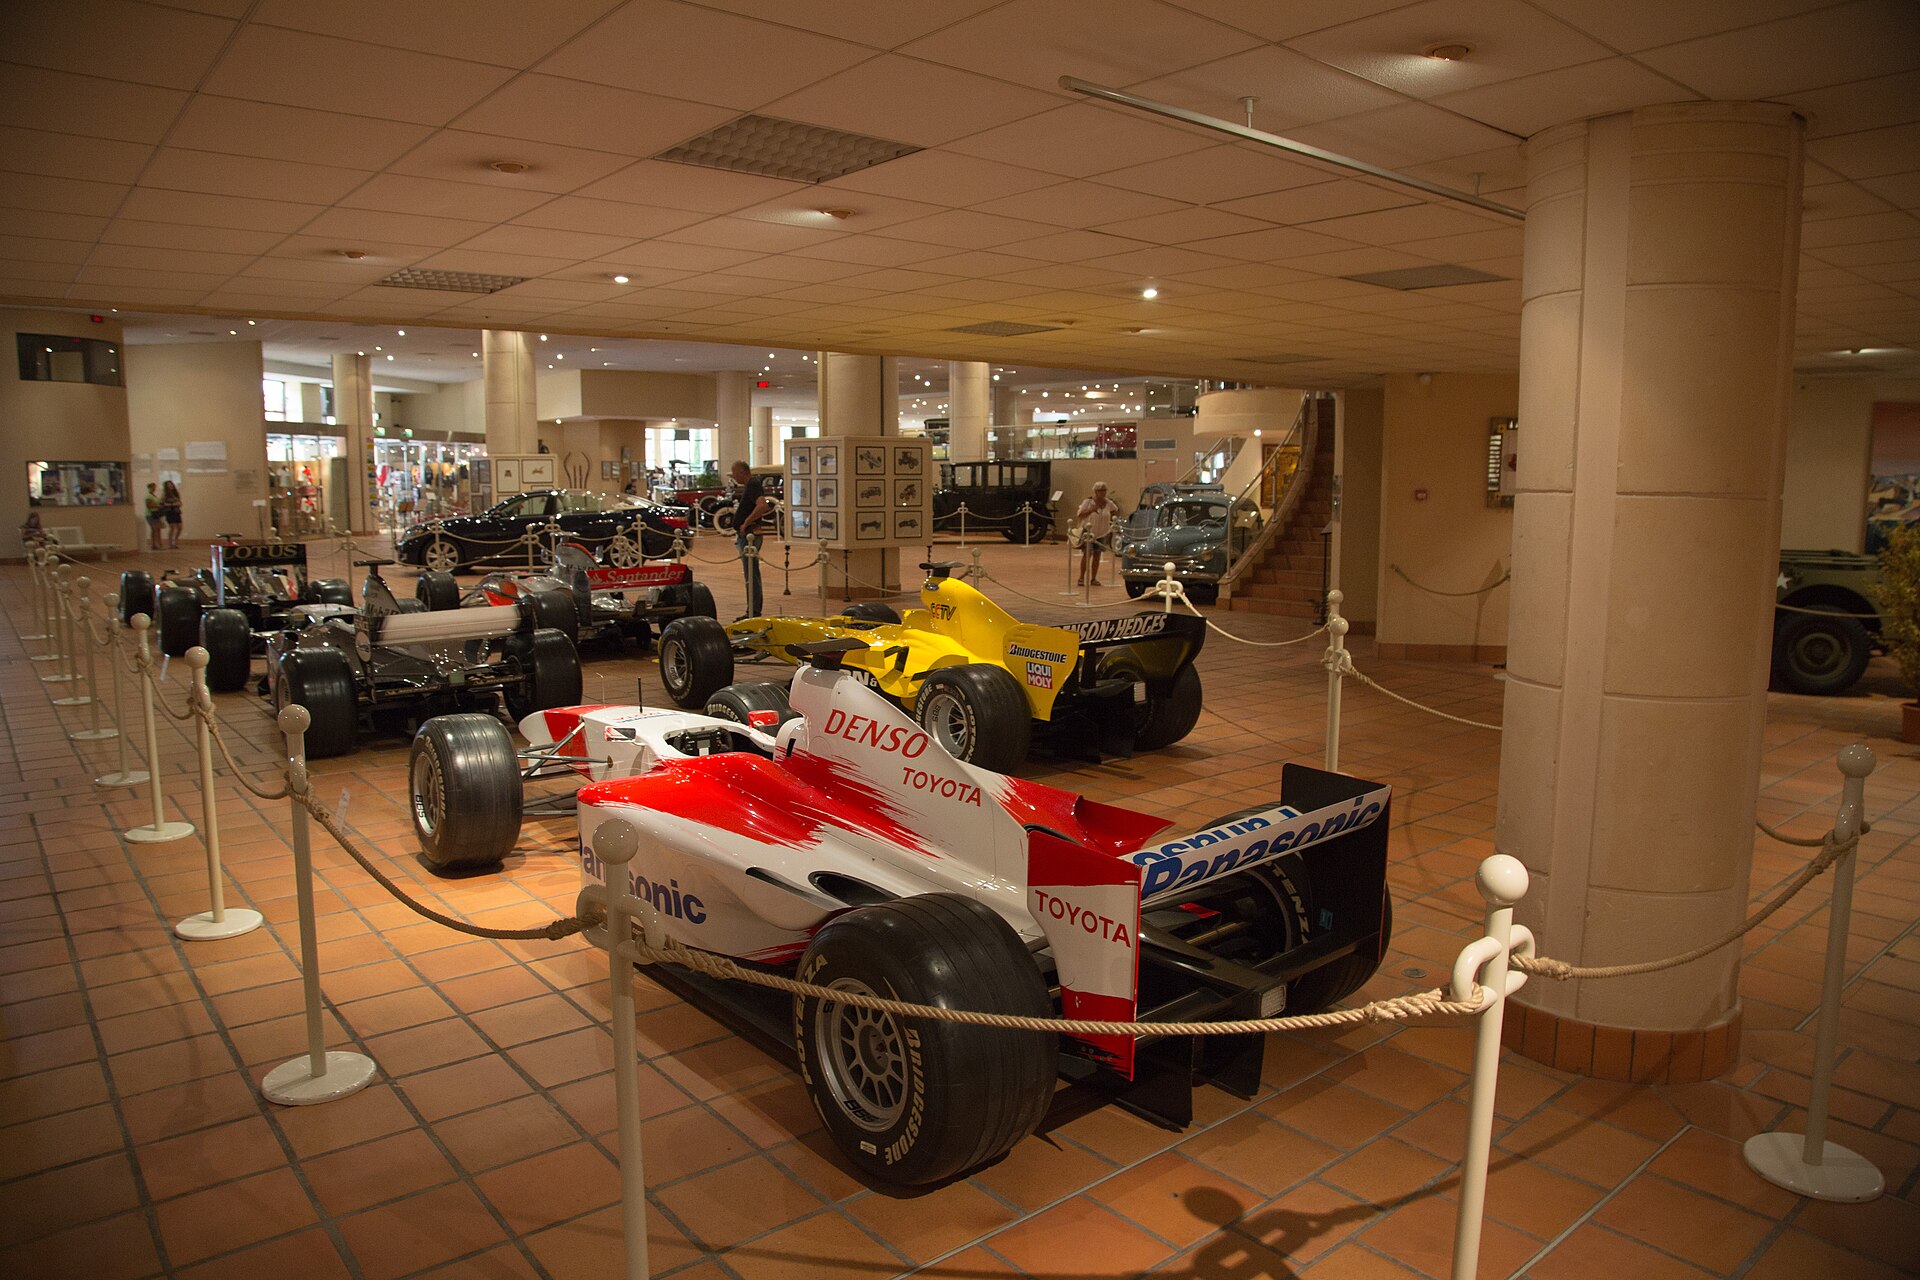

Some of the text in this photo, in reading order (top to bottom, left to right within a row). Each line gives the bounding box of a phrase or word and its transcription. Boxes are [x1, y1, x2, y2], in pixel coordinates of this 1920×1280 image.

[224, 545, 297, 560] LOTUS
[607, 567, 685, 582] Santander
[931, 603, 957, 621] CCTV
[1008, 643, 1067, 664] BRIDGESTONE
[1027, 662, 1051, 677] LIQUI
[1027, 674, 1052, 689] MOLY
[824, 709, 929, 759] DENSO
[902, 767, 981, 807] TOYOTA
[1141, 796, 1382, 900] Panasonic
[1035, 890, 1131, 948] TOYOTA
[795, 954, 829, 1085] POTEZA
[885, 1026, 925, 1166] BRIDGESTONE
